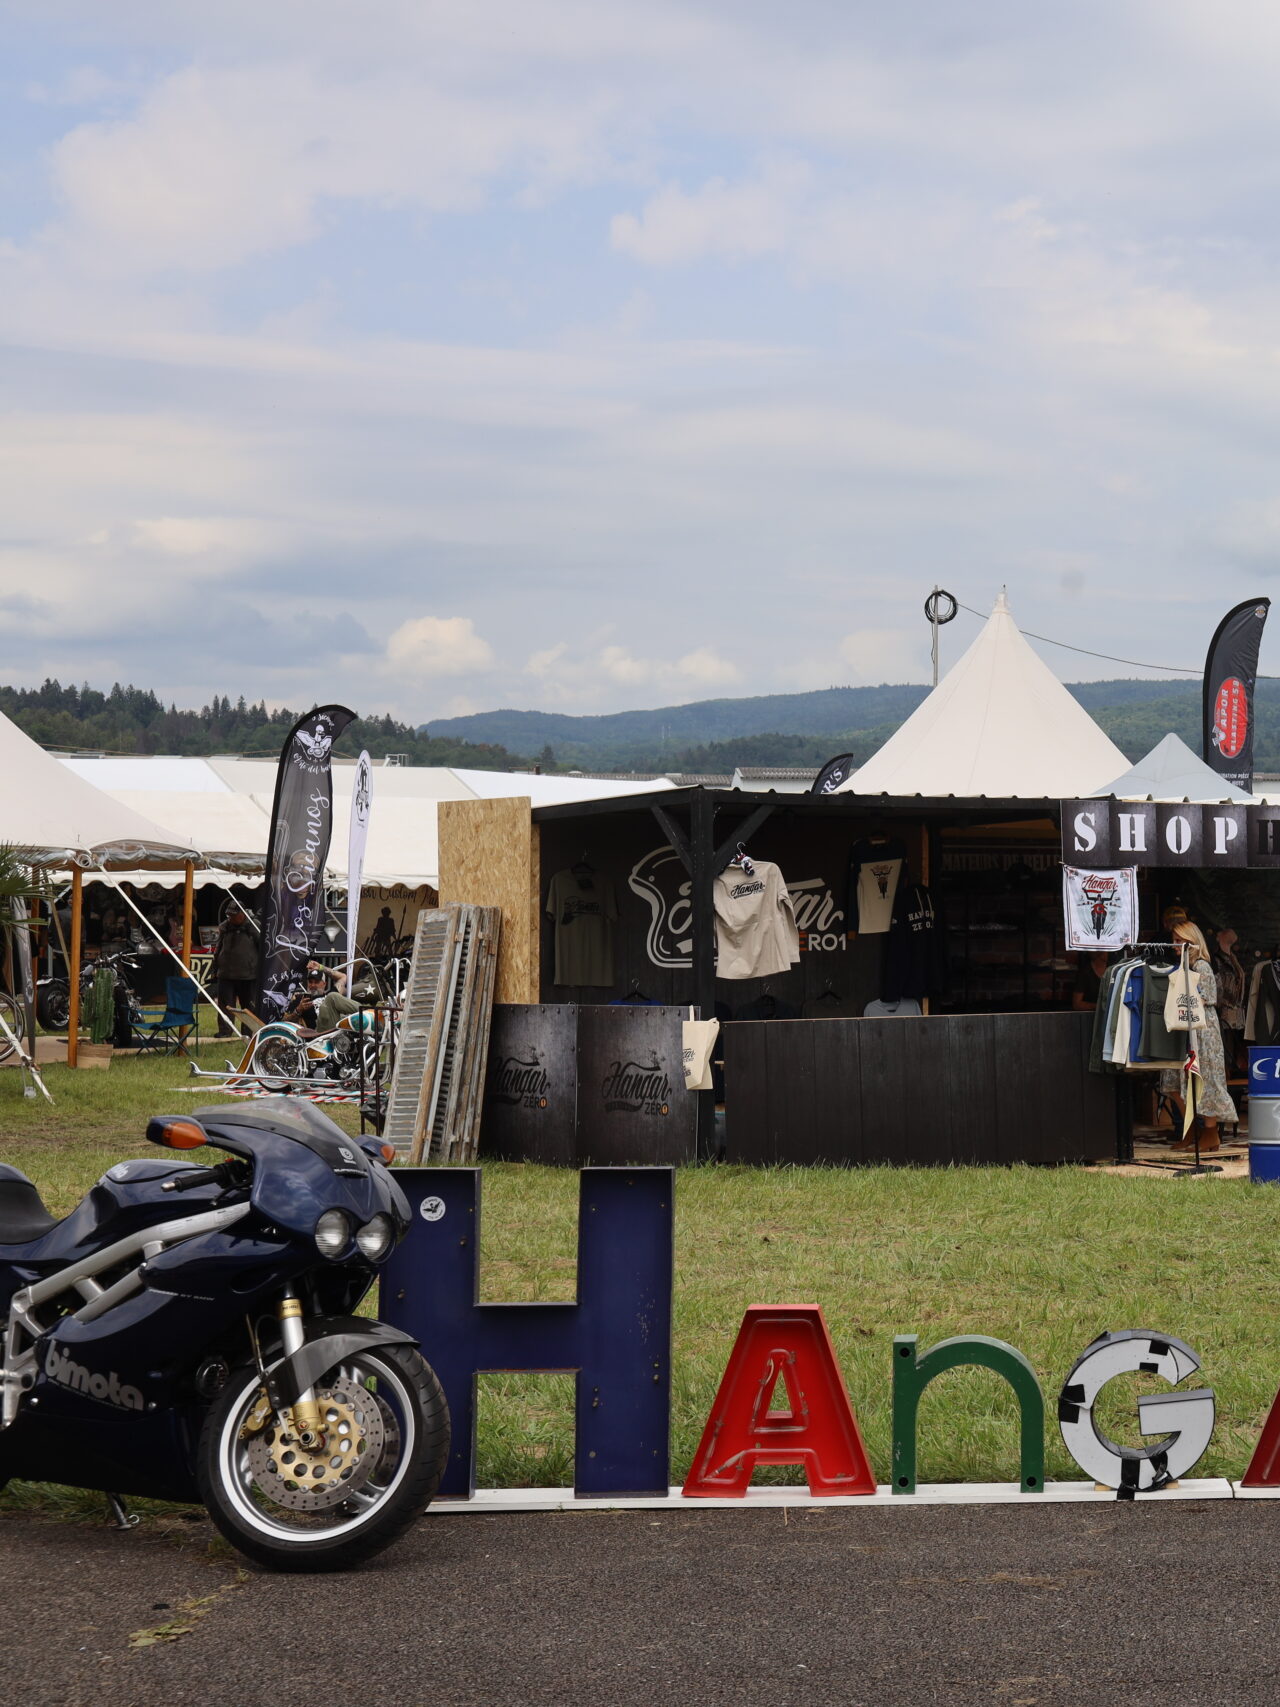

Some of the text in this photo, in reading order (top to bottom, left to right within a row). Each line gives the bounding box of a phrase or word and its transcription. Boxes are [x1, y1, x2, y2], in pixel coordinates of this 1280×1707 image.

[1230, 698, 1239, 752] BLASTING
[1074, 812, 1238, 854] SHOP
[276, 787, 330, 961] Los Sicanos
[730, 881, 766, 897] Hangar
[1082, 874, 1118, 893] Hangar
[603, 1061, 672, 1106] Hangar
[44, 1339, 144, 1411] bimota
